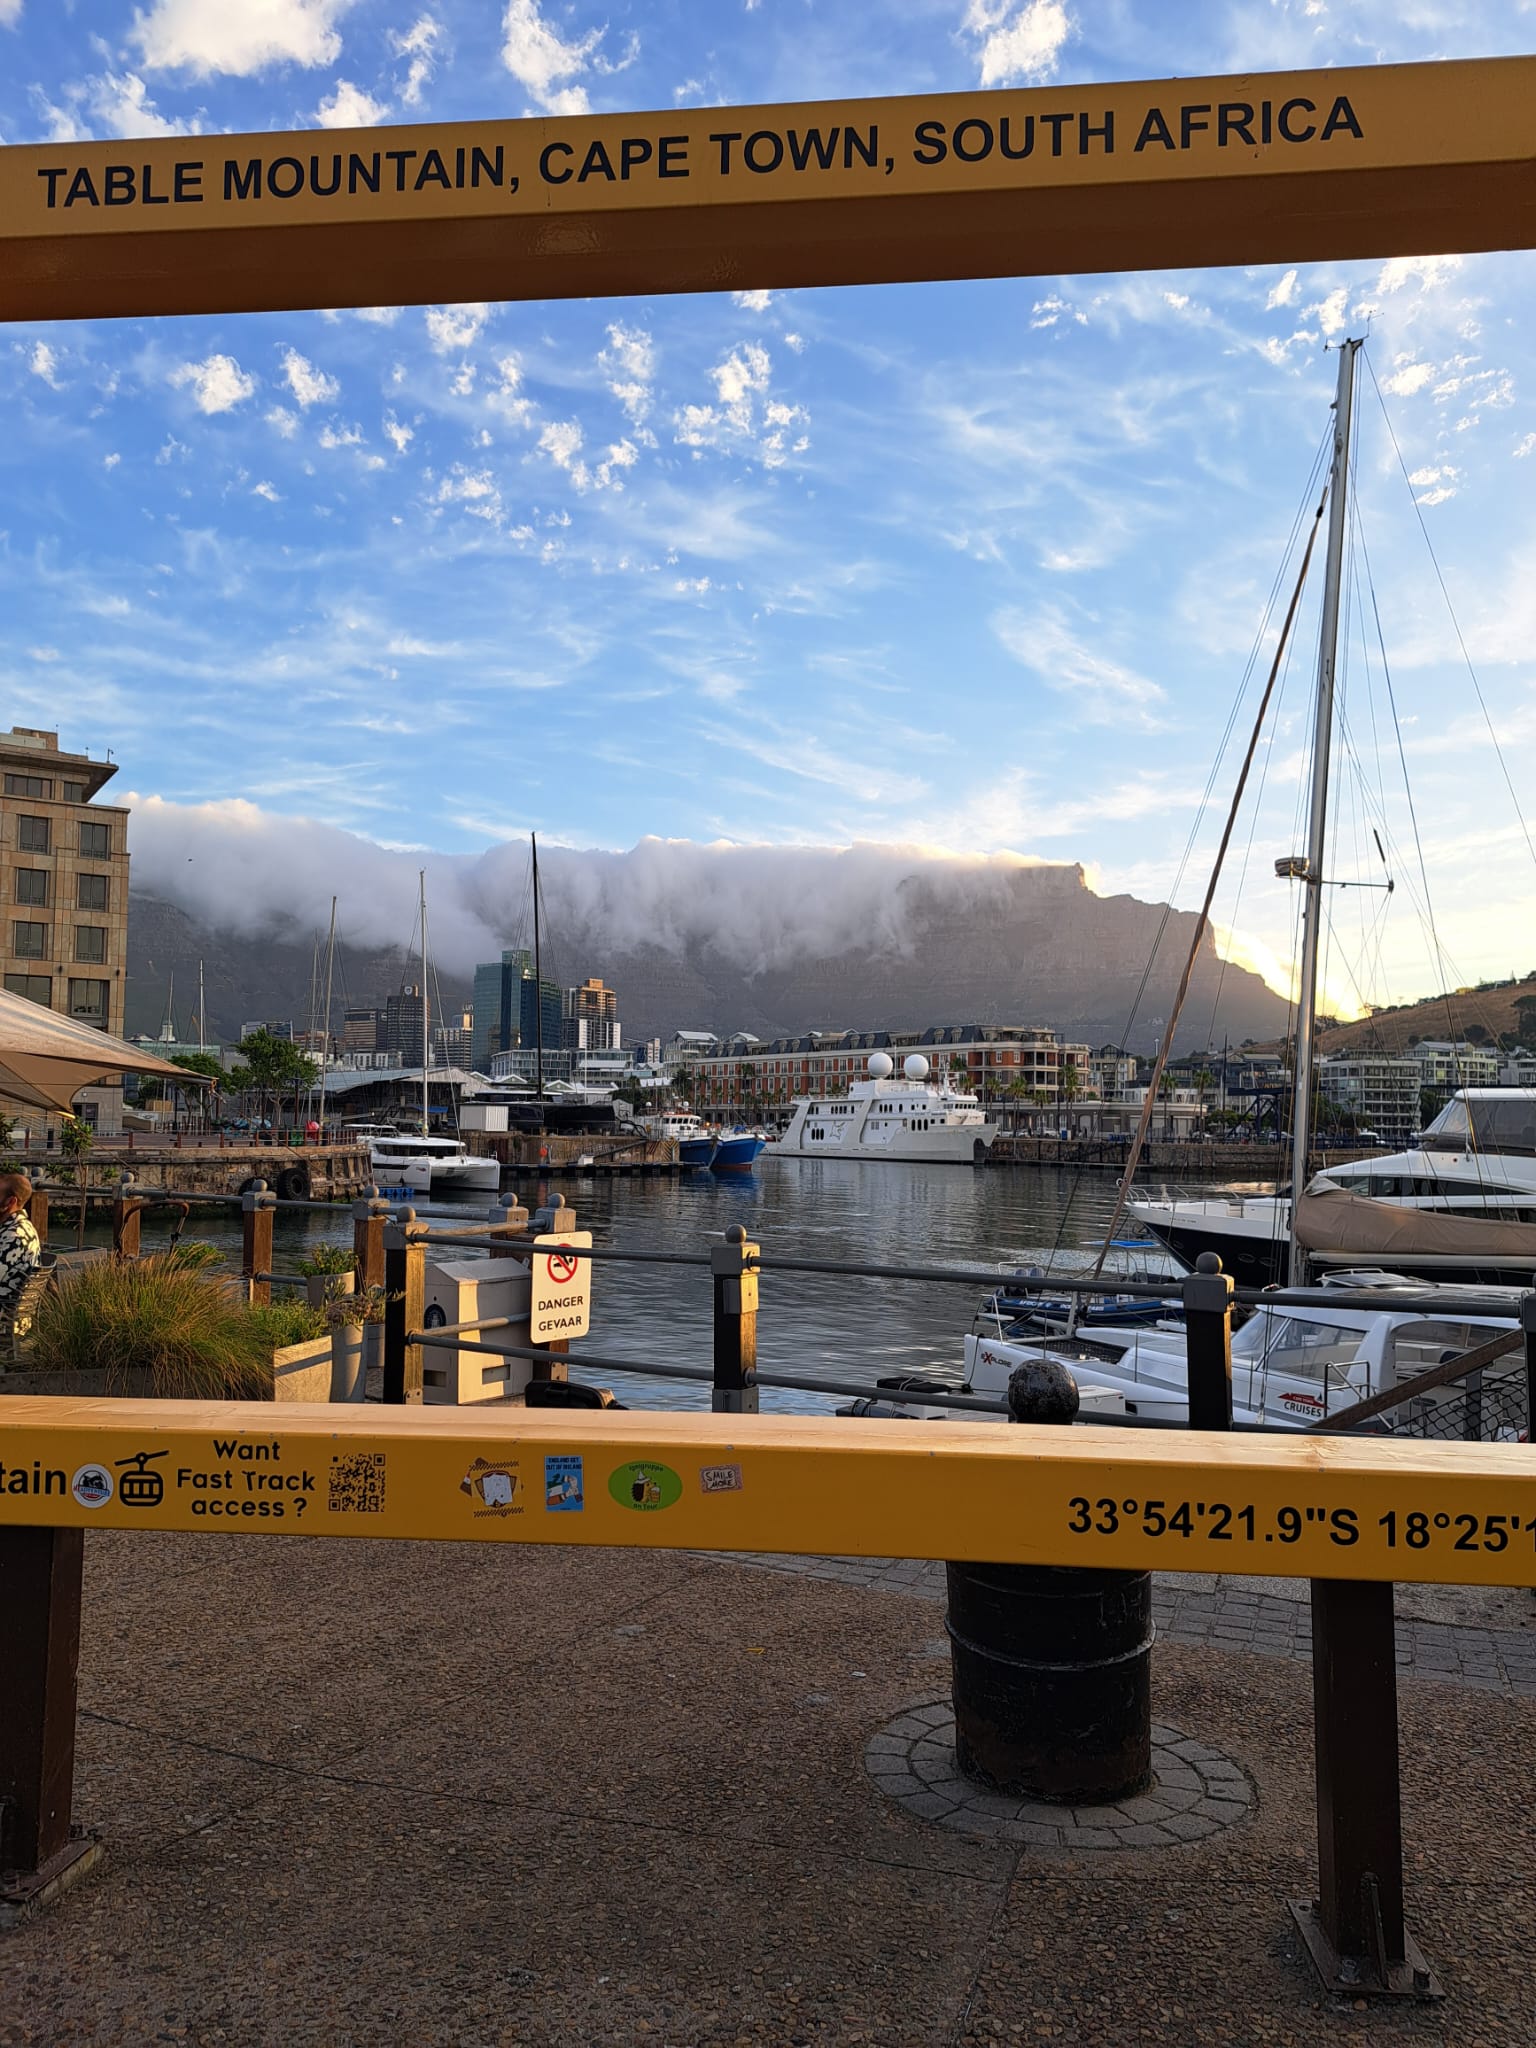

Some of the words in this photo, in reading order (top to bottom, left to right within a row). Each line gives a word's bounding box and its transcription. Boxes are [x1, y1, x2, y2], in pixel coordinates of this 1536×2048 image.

[38, 162, 204, 209] TABLE
[224, 146, 520, 201] MOUNTAIN,
[540, 136, 690, 185] CAPE
[710, 126, 895, 176] TOWN,
[913, 111, 1115, 165] SOUTH
[1134, 96, 1364, 153] AFRICA
[538, 1295, 584, 1311] DANGER
[538, 1315, 582, 1331] GEVAAR
[1283, 1401, 1322, 1417] CRUISES
[214, 1440, 281, 1461] Want
[177, 1469, 233, 1489] Fast
[242, 1471, 315, 1491] Track
[705, 1470, 733, 1482] SMILE
